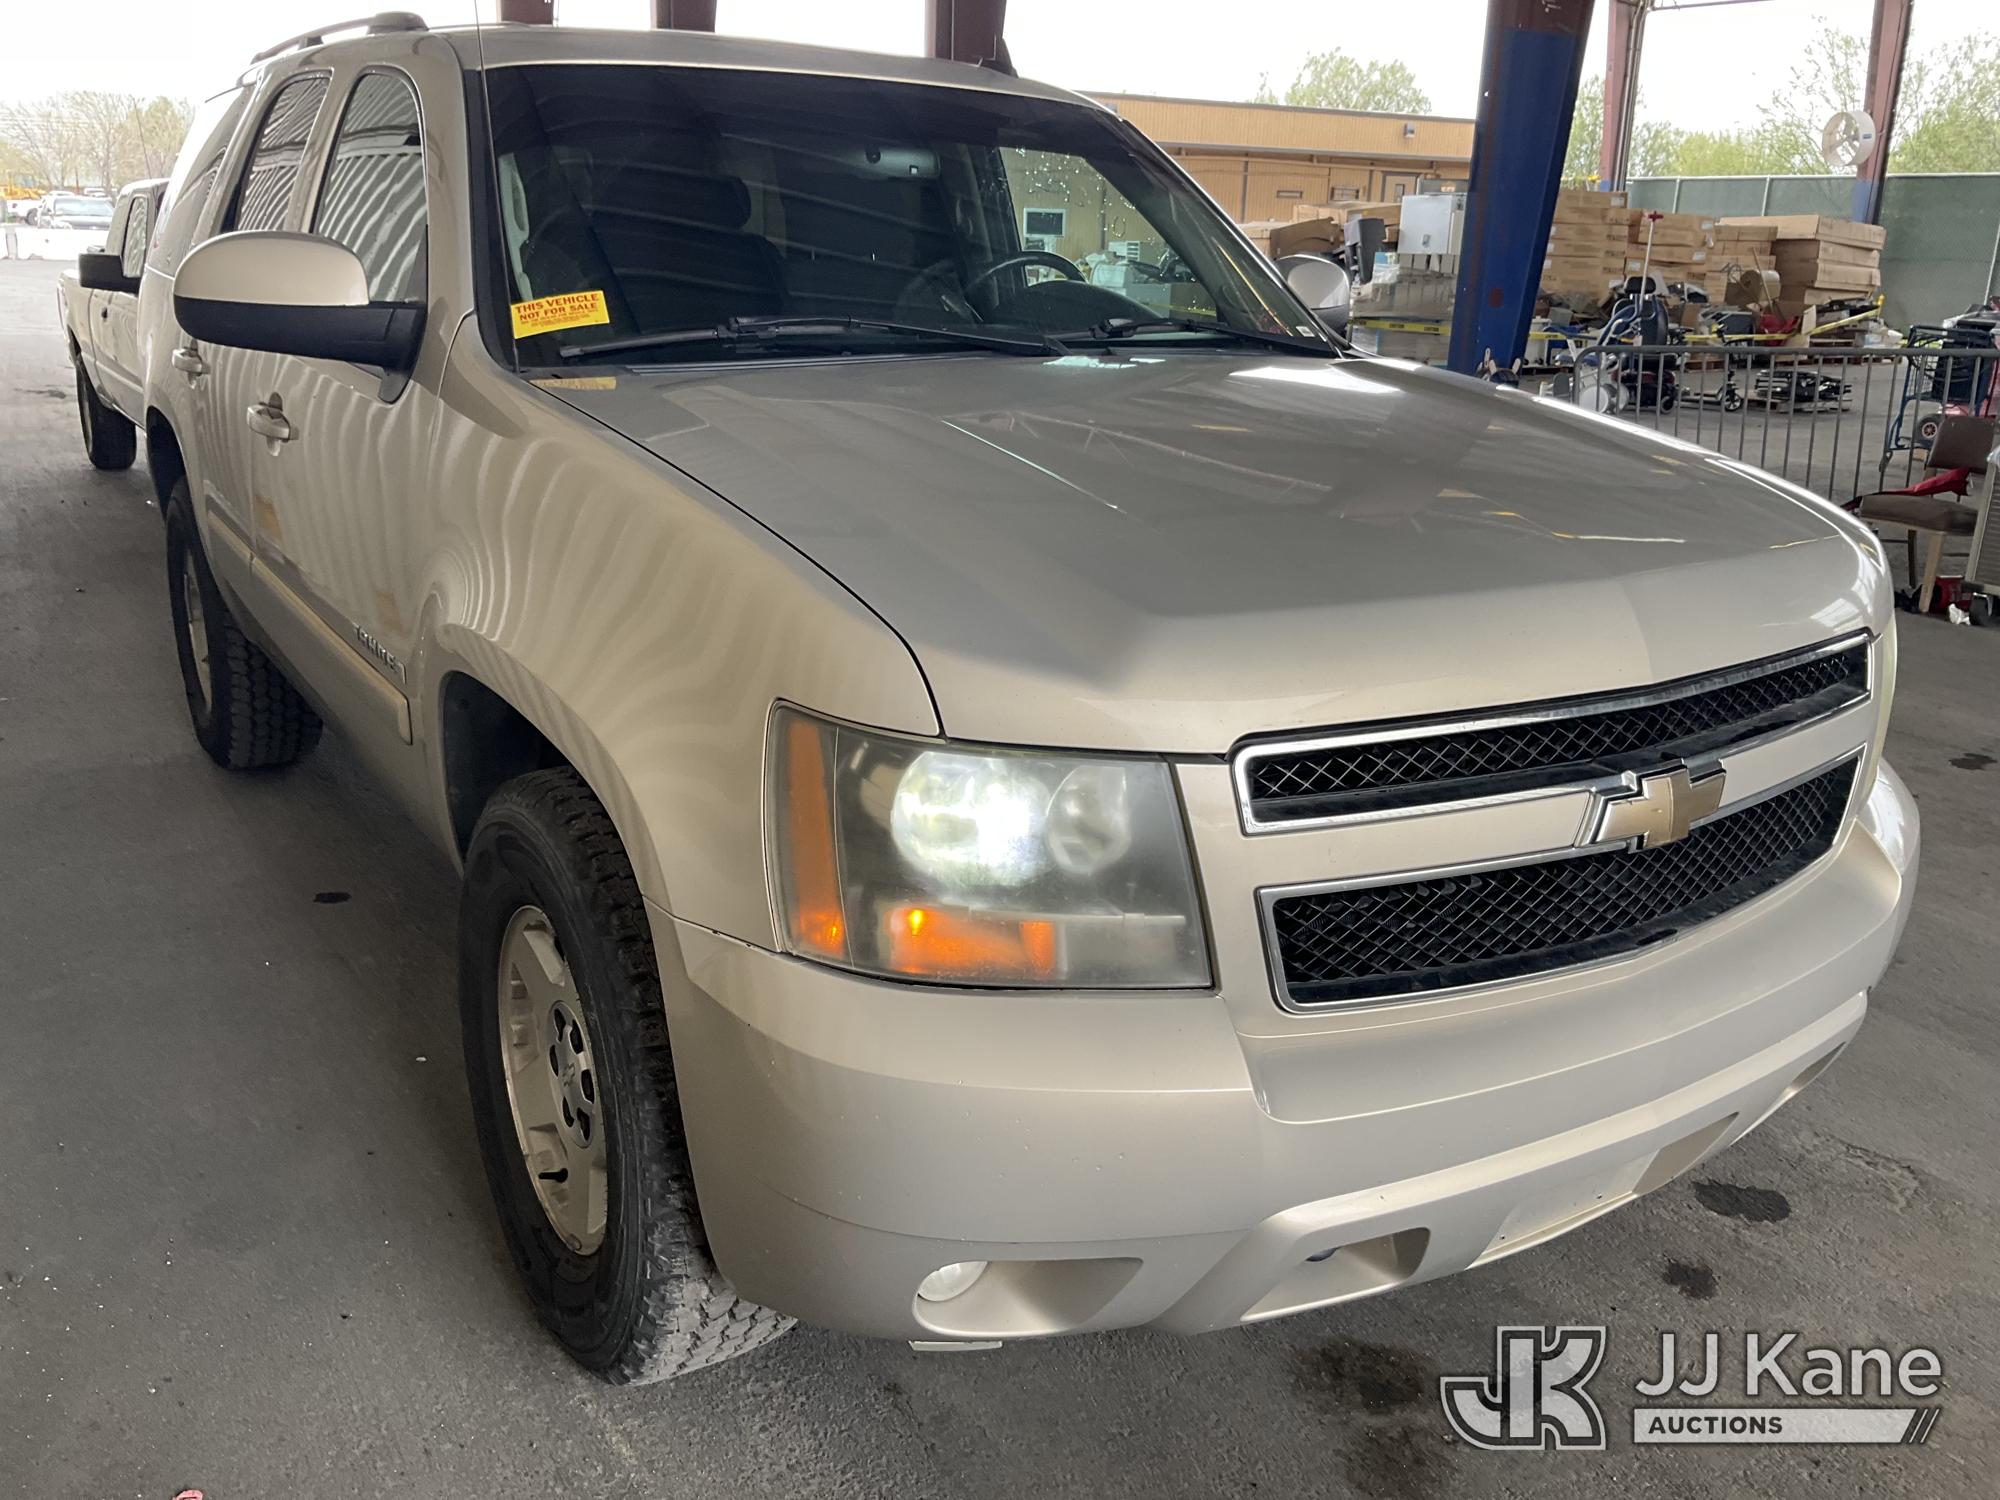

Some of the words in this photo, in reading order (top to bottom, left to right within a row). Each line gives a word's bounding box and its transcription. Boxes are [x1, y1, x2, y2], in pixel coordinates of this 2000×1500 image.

[515, 302, 544, 314] THIS
[546, 293, 599, 307] VEHICLE
[520, 312, 540, 321] NOT
[544, 306, 566, 317] FOR
[570, 303, 597, 312] SALE
